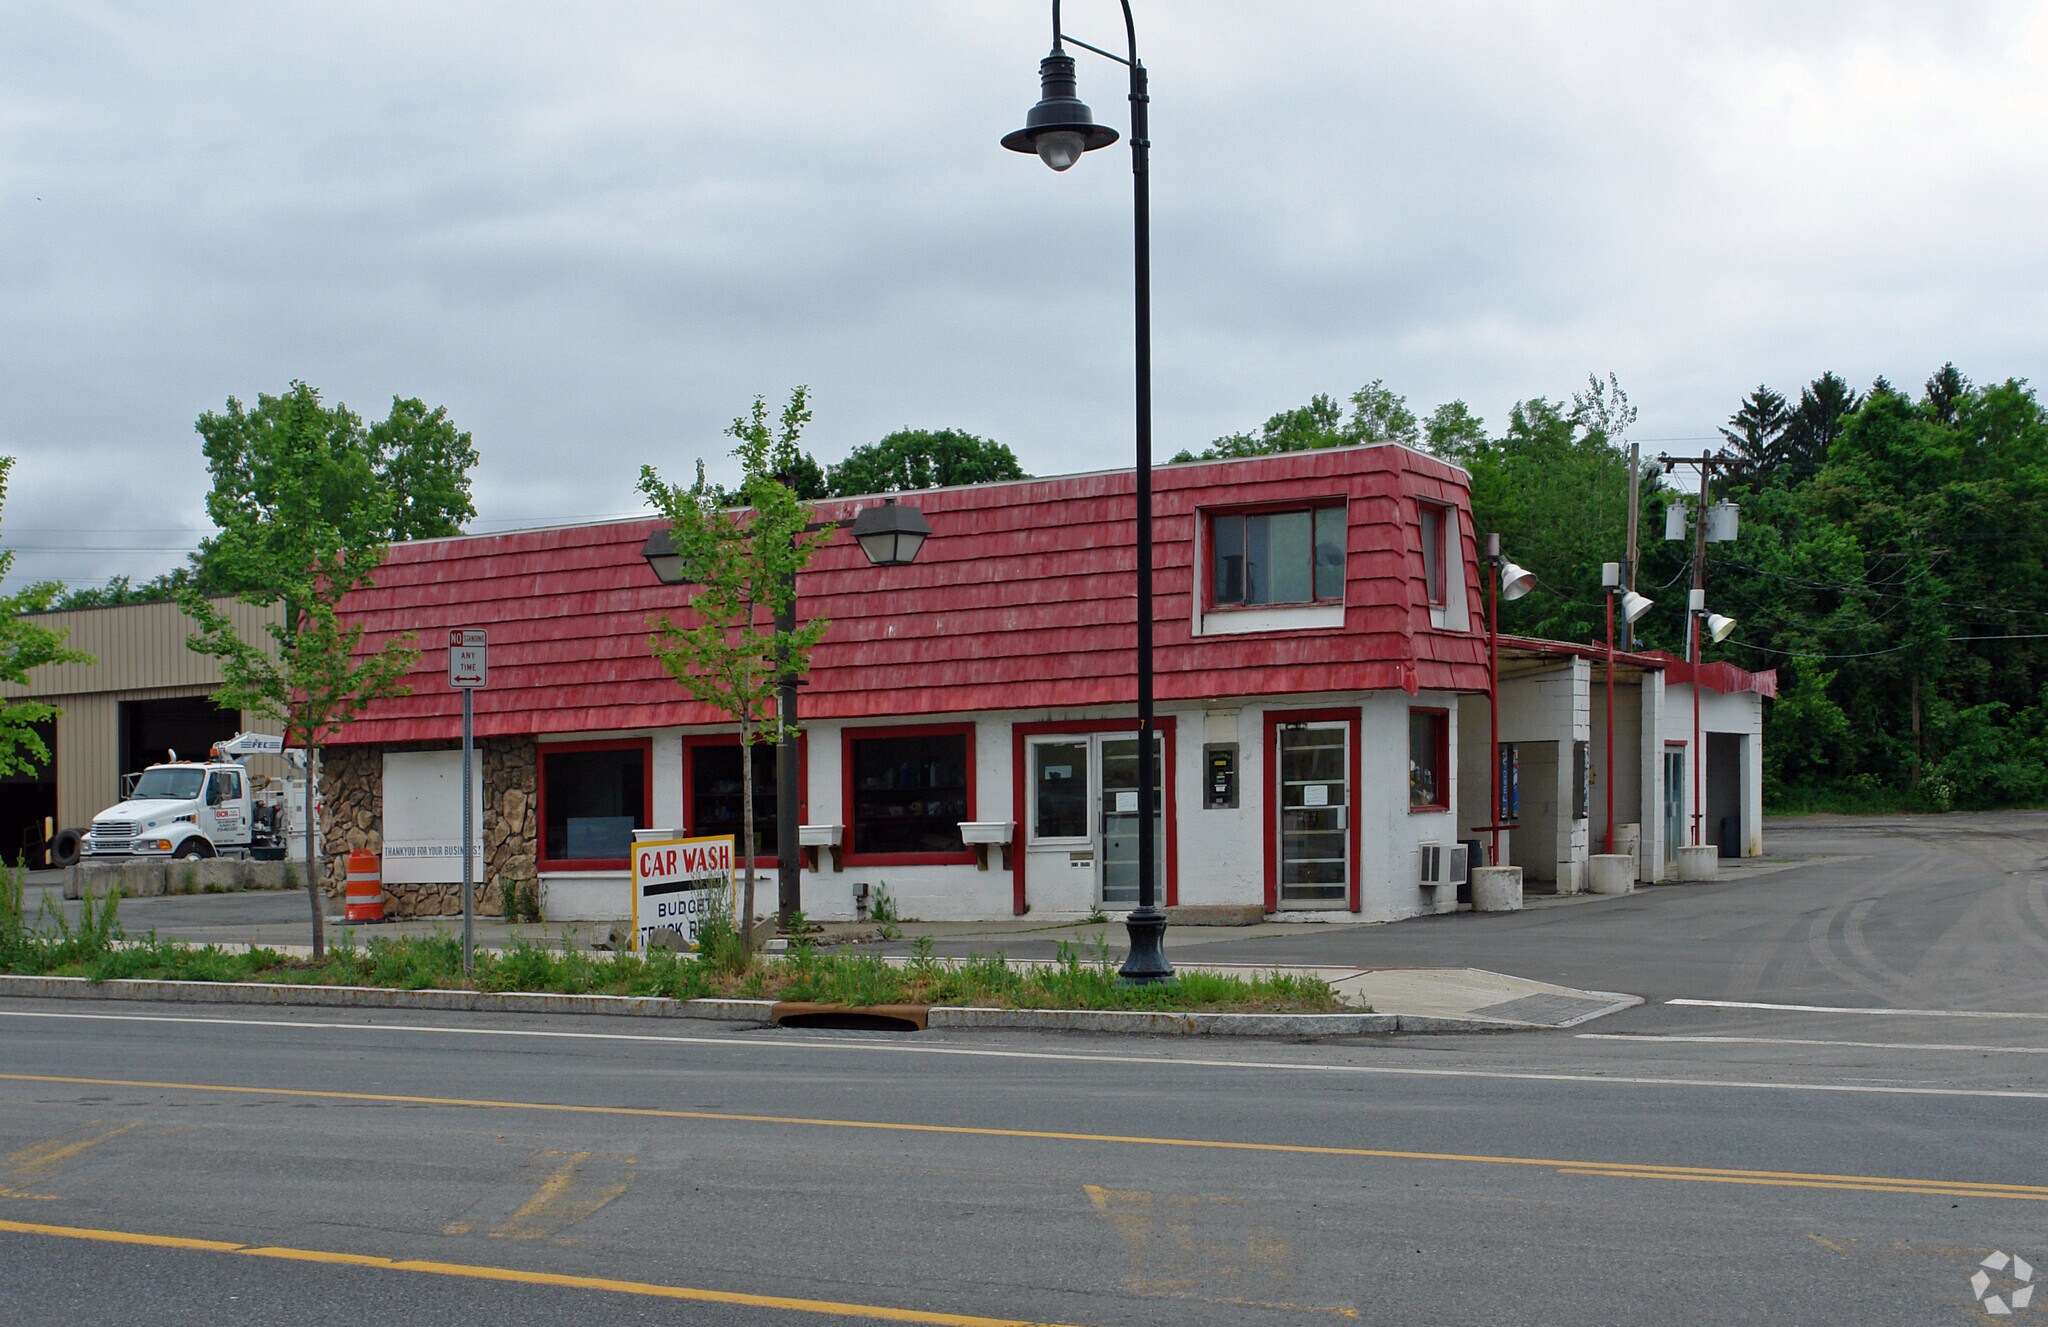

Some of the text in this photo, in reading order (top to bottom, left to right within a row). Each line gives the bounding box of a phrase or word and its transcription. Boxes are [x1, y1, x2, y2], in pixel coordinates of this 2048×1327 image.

[451, 633, 485, 644] NO STANDING
[461, 651, 475, 659] ANY
[460, 663, 477, 671] TIME
[417, 846, 428, 856] FOR
[428, 846, 443, 856] YOUR
[444, 845, 481, 856] BUSINS!
[640, 845, 729, 878] CAR WASH
[658, 898, 710, 917] BUDGET
